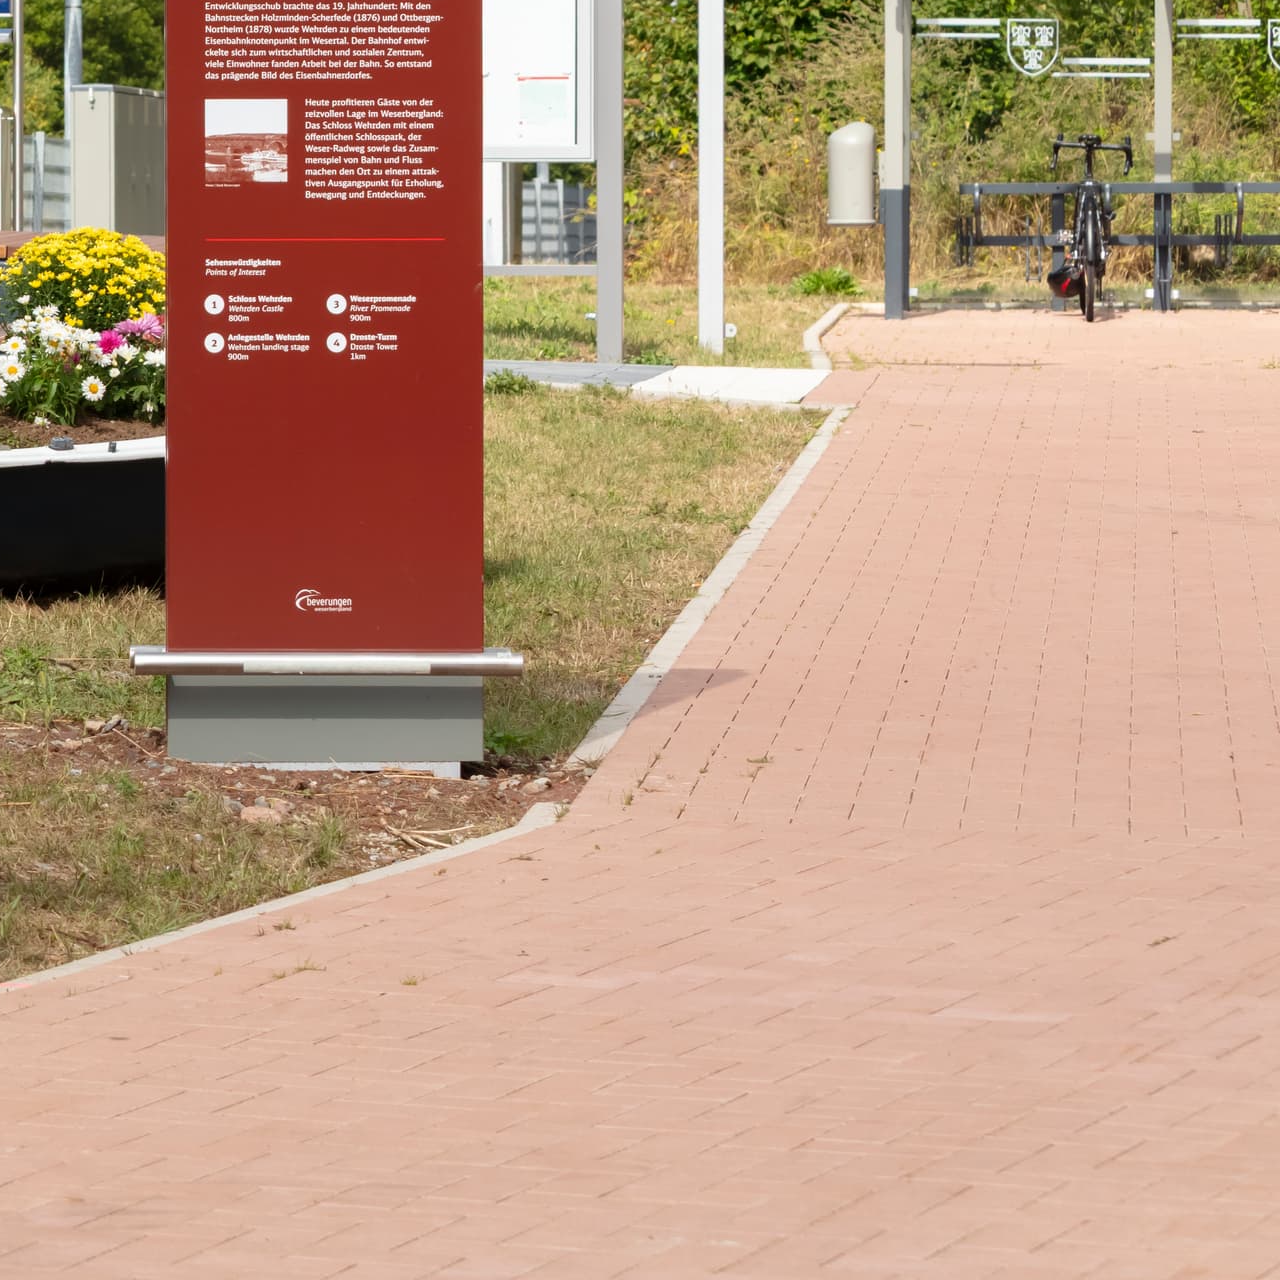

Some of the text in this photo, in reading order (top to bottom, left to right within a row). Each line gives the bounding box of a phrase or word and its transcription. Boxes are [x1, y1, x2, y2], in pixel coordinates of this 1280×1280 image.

[305, 98, 329, 106] Heute
[332, 98, 374, 108] profitieren
[377, 98, 400, 106] Gäste
[419, 98, 434, 106] der
[305, 109, 344, 118] reizvollen
[347, 109, 366, 119] Lage
[381, 109, 444, 119] Weserbergland:
[305, 121, 434, 129] Das Schloss Wehrden mit einem
[305, 133, 422, 143] öffentlichen Schlosspark, der
[305, 144, 439, 154] Weser-Radweg sowie das Zusam-
[305, 156, 341, 166] menspiel
[361, 156, 381, 164] Bahn
[384, 156, 399, 164] und
[402, 156, 423, 164] Fluss
[305, 167, 336, 176] machen
[339, 167, 354, 176] den
[357, 167, 370, 176] Ort
[385, 167, 409, 176] einem
[305, 179, 444, 189] tiven Ausgangspunkt für Erholung,
[305, 191, 426, 201] Bewegung und Entdeckungen.
[205, 258, 281, 268] Sehenswürdigkeiten
[205, 268, 227, 276] Points
[239, 268, 266, 276] Interest
[228, 295, 292, 303] Schloss Wehrden
[350, 294, 416, 304] Weserpromenade
[229, 304, 284, 313] Wehrden Castle
[350, 304, 411, 312] River Promenade
[228, 314, 250, 322] 800m
[349, 314, 371, 322] 900m
[227, 333, 310, 343] Anlegestelle Wehrden
[350, 333, 397, 342] Droste-Turm
[228, 343, 310, 353] Wehrden landing stage
[350, 343, 398, 351] Droste Tower
[227, 352, 249, 361] 900m
[350, 352, 366, 361] 1km
[307, 598, 352, 608] beverungen
